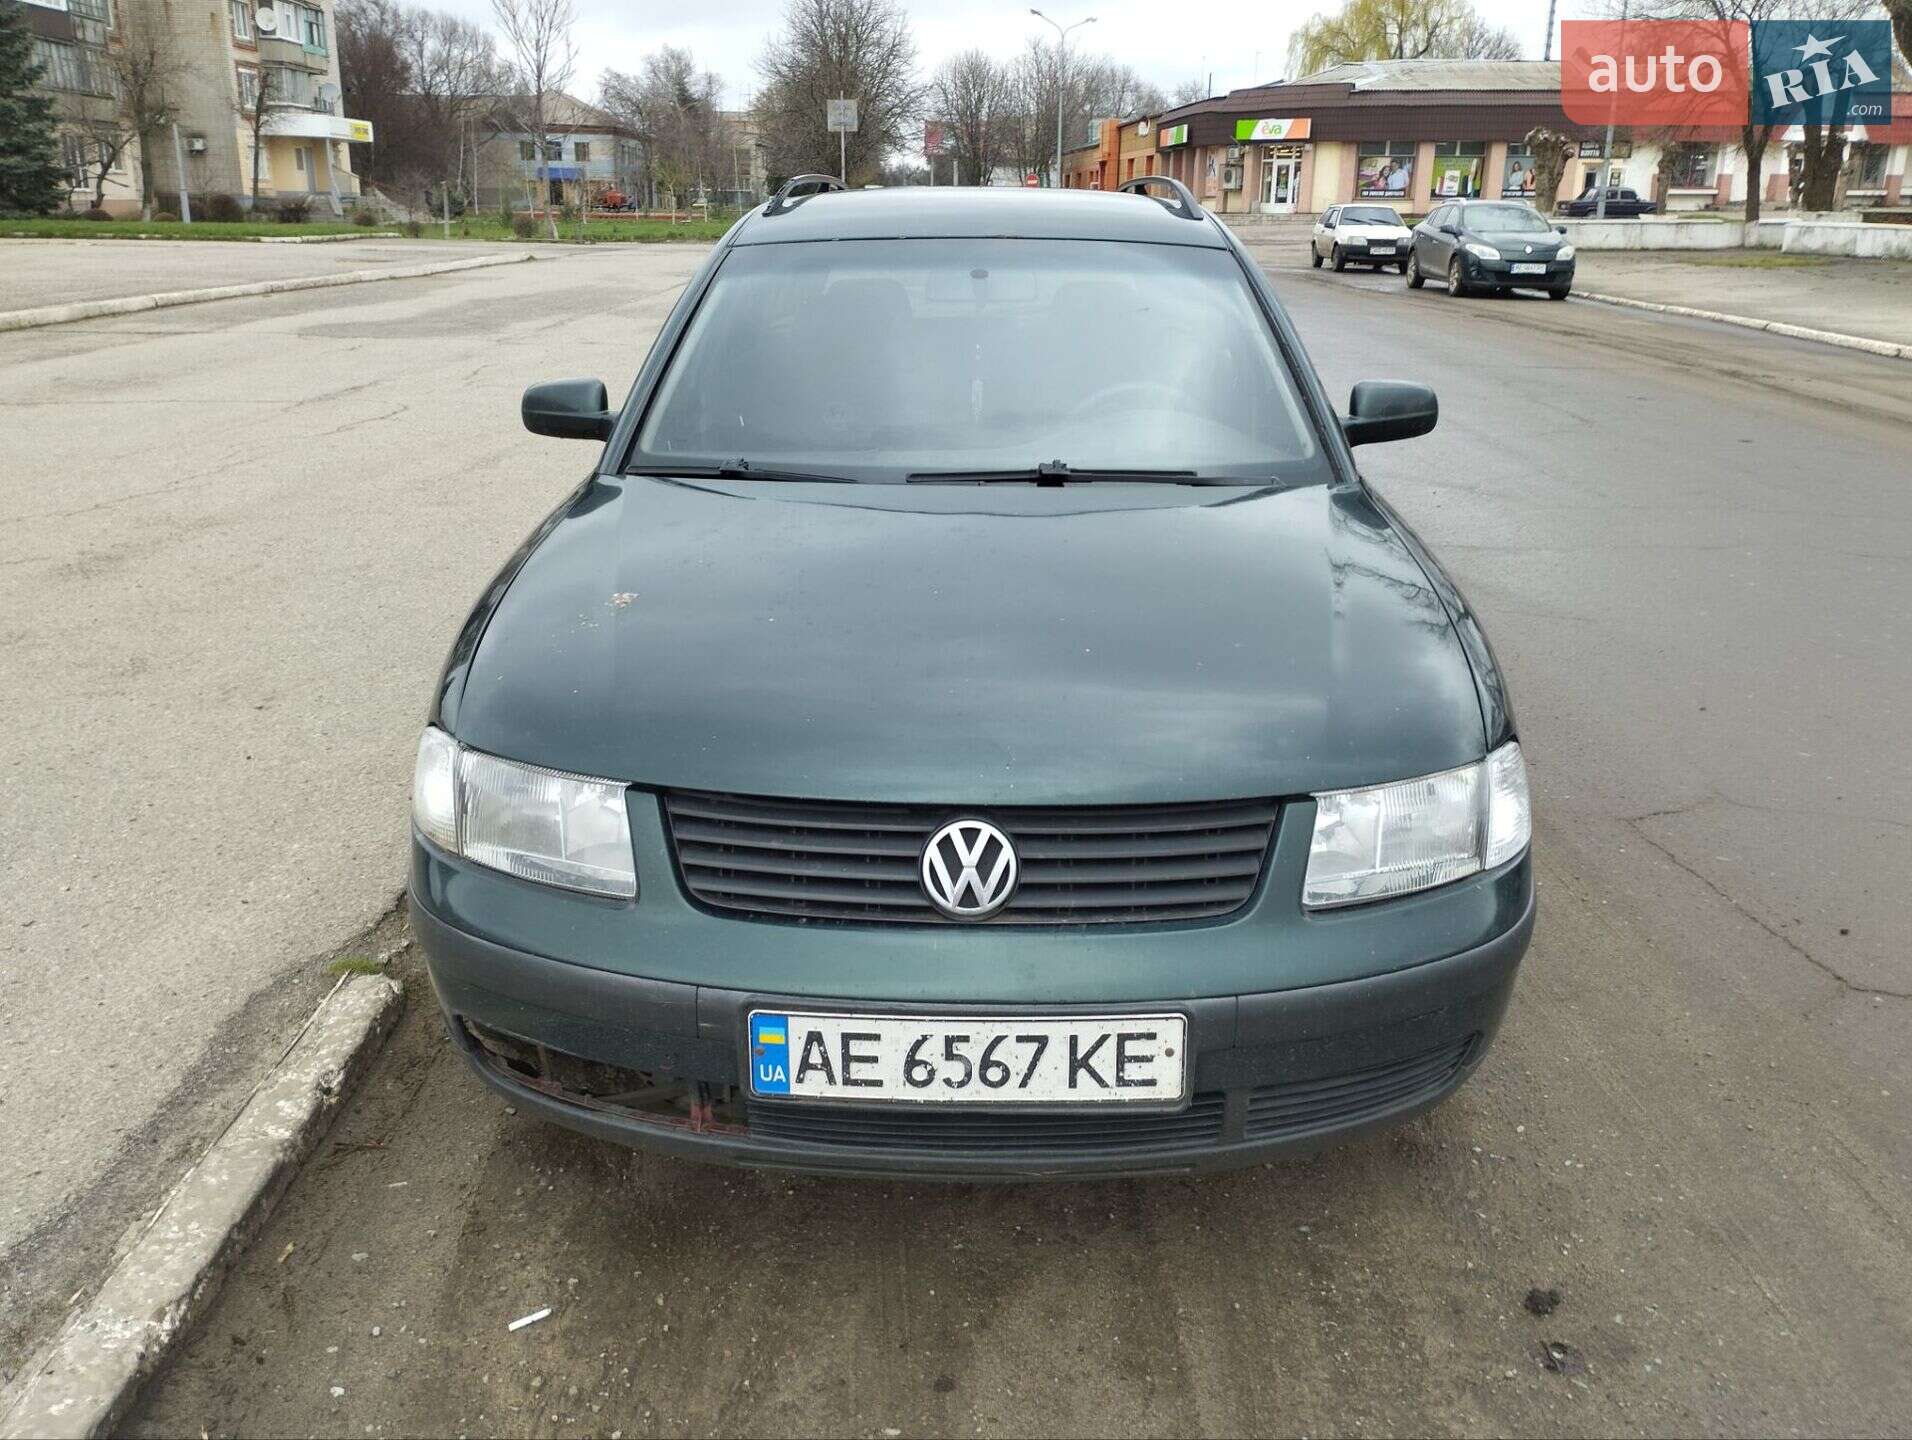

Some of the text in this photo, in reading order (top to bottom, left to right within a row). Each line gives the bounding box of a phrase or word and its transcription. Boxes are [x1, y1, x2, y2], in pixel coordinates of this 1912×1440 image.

[759, 1063, 787, 1083] UA
[795, 1030, 1158, 1089] AE 6567 KE
